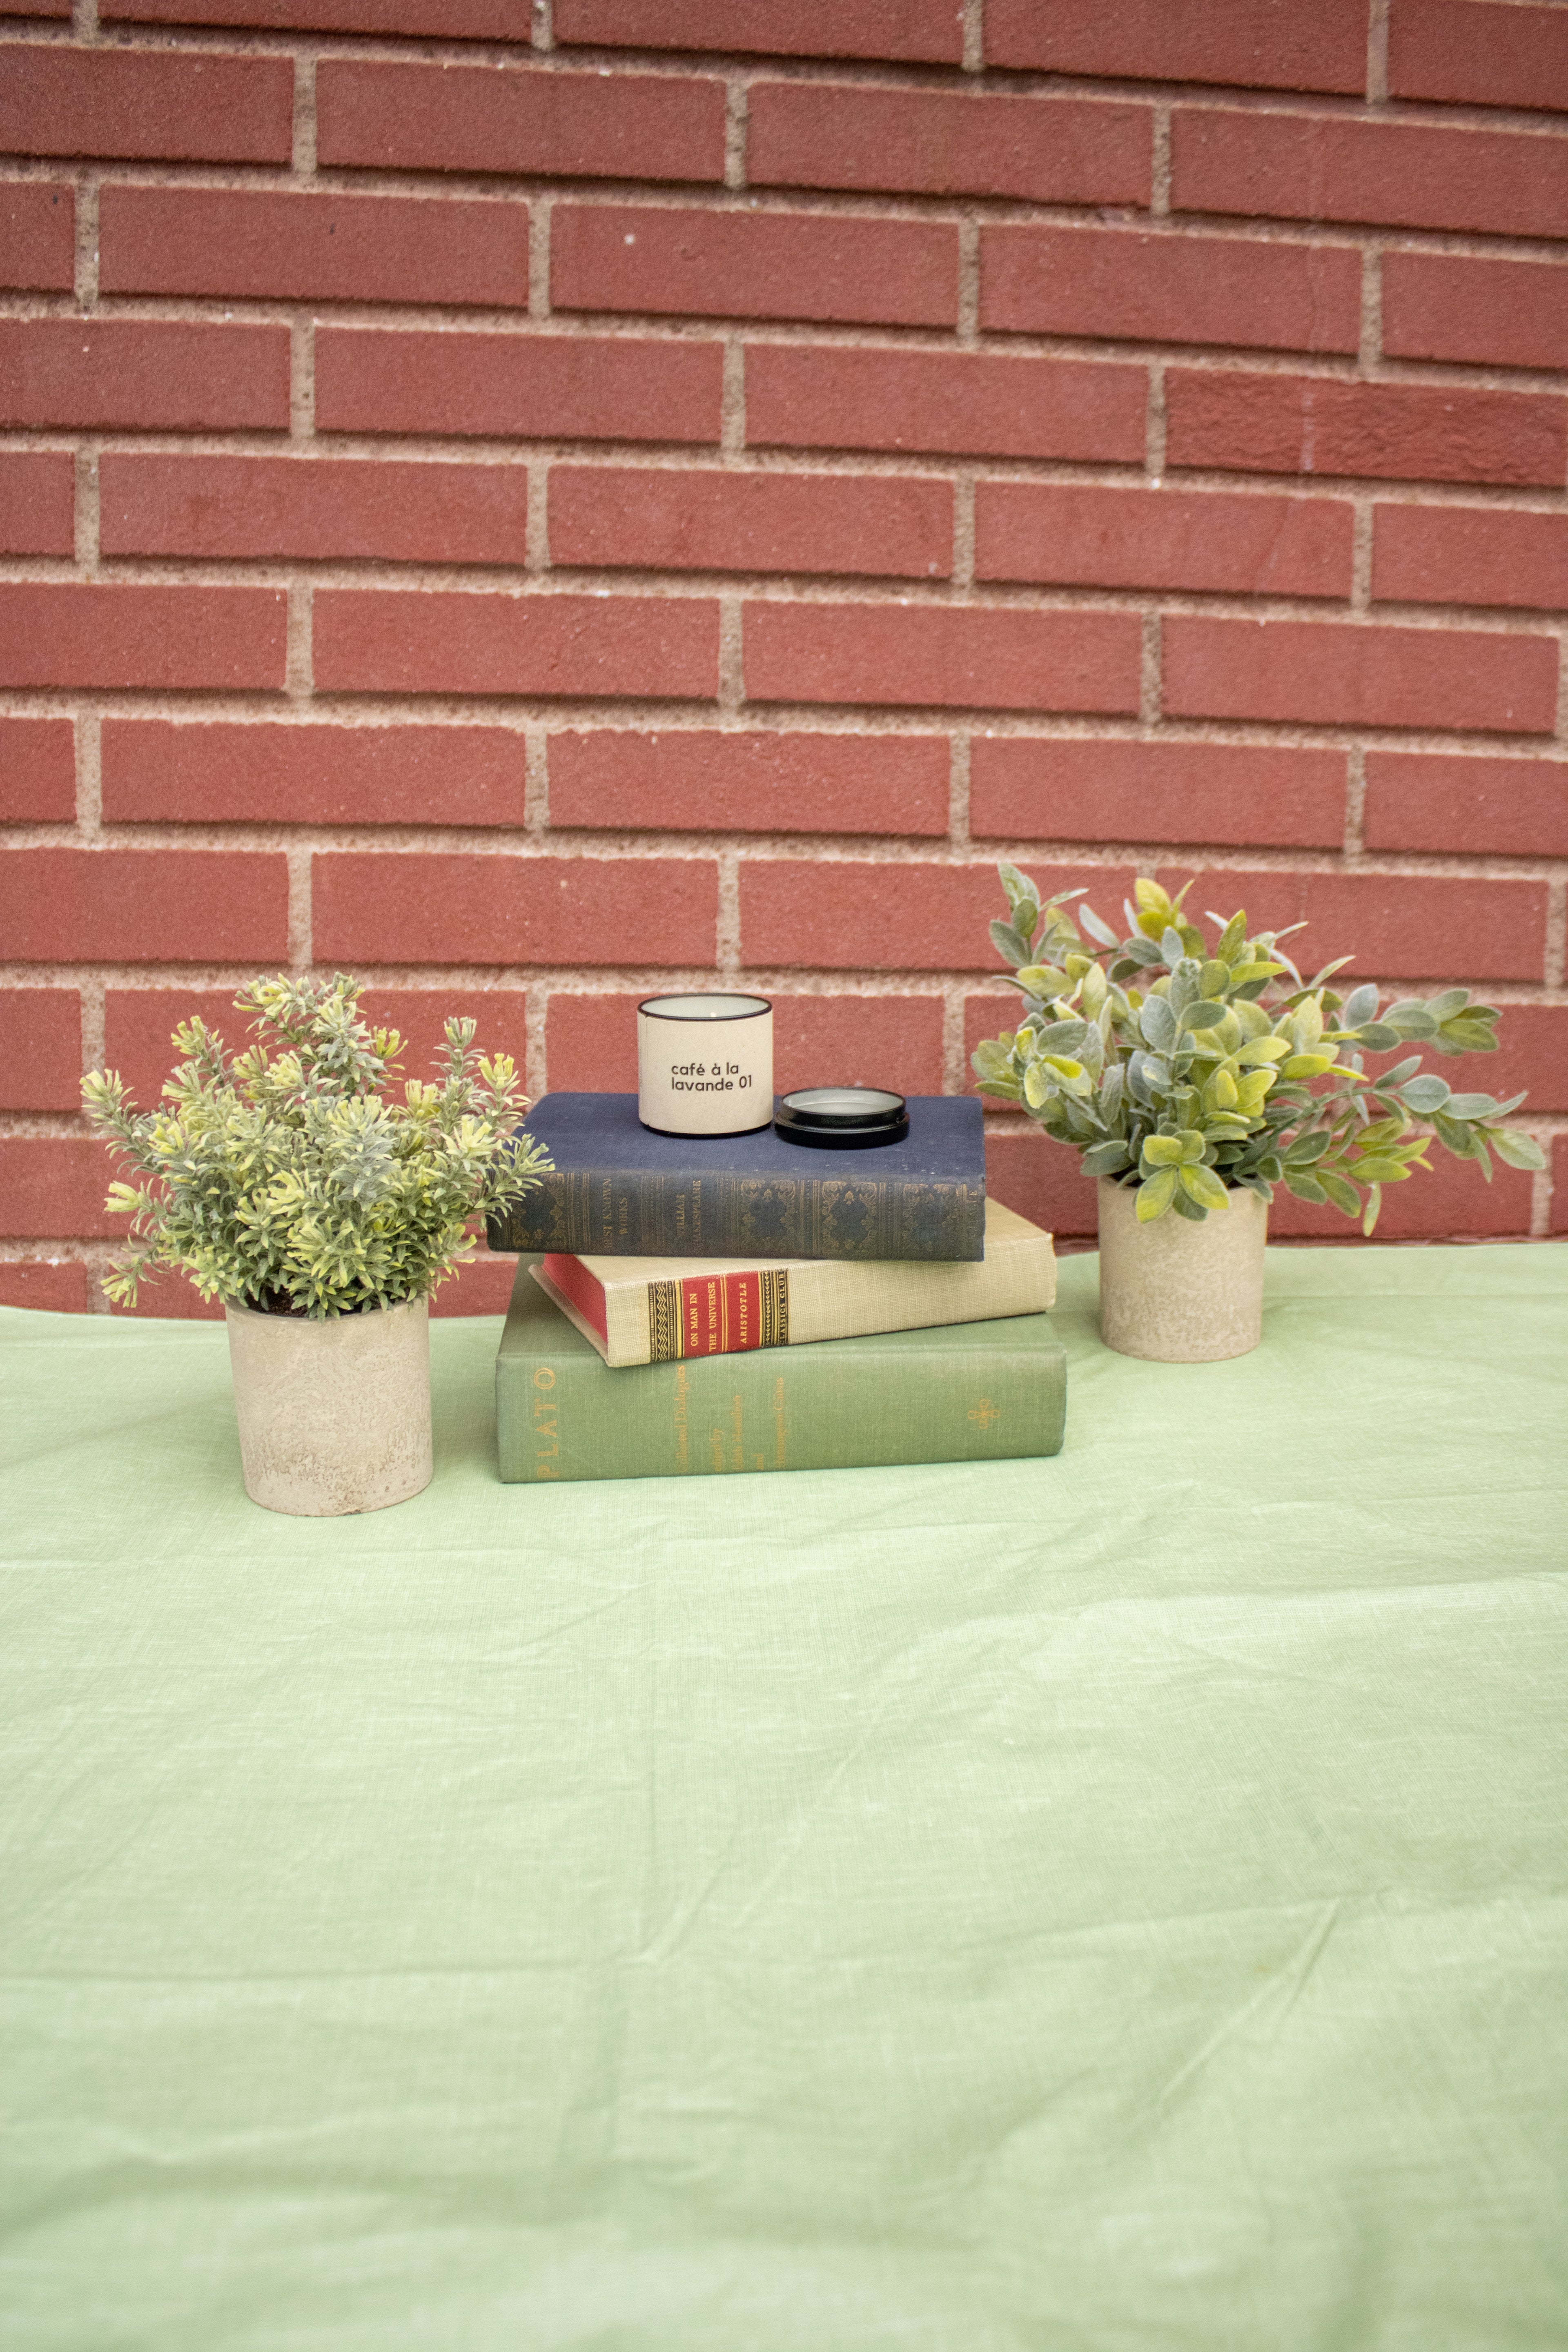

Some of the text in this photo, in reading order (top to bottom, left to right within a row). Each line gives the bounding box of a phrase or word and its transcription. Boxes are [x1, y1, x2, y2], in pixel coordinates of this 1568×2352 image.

[671, 1062, 739, 1076] café à la
[671, 1075, 752, 1091] lavande 01
[602, 1178, 612, 1219] KNOWN
[618, 1197, 628, 1235] WORKS
[693, 1180, 701, 1243] AKESPEARE
[689, 1293, 699, 1347] ON MAN IN
[708, 1282, 717, 1352] THE UNIVERSE
[739, 1282, 748, 1344] ARISTOTLE
[674, 1365, 690, 1421] Dialogues
[534, 1368, 559, 1478] PLATO
[709, 1428, 724, 1441] by
[752, 1453, 764, 1470] and
